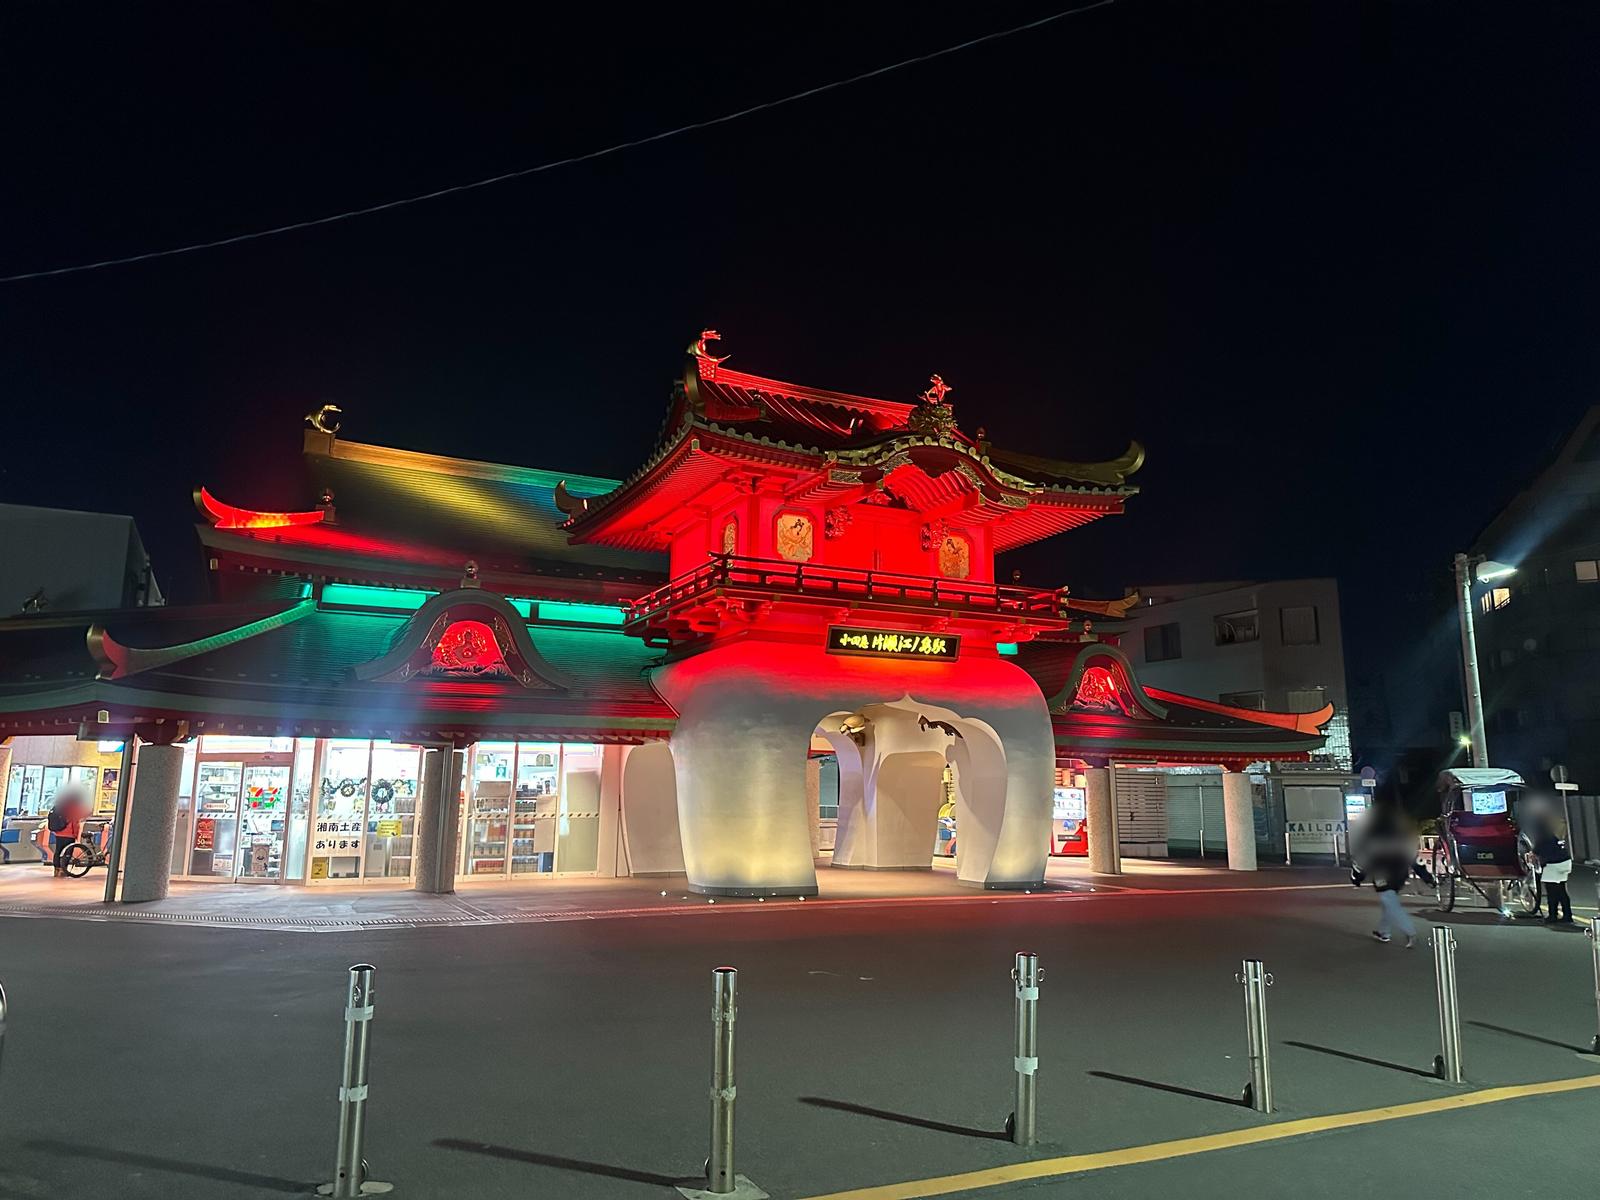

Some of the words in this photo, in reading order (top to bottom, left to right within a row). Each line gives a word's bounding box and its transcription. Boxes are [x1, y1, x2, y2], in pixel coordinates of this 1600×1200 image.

[316, 822, 361, 832] 湘南土産
[1288, 823, 1343, 832] KAILOA
[315, 839, 360, 850] あります
